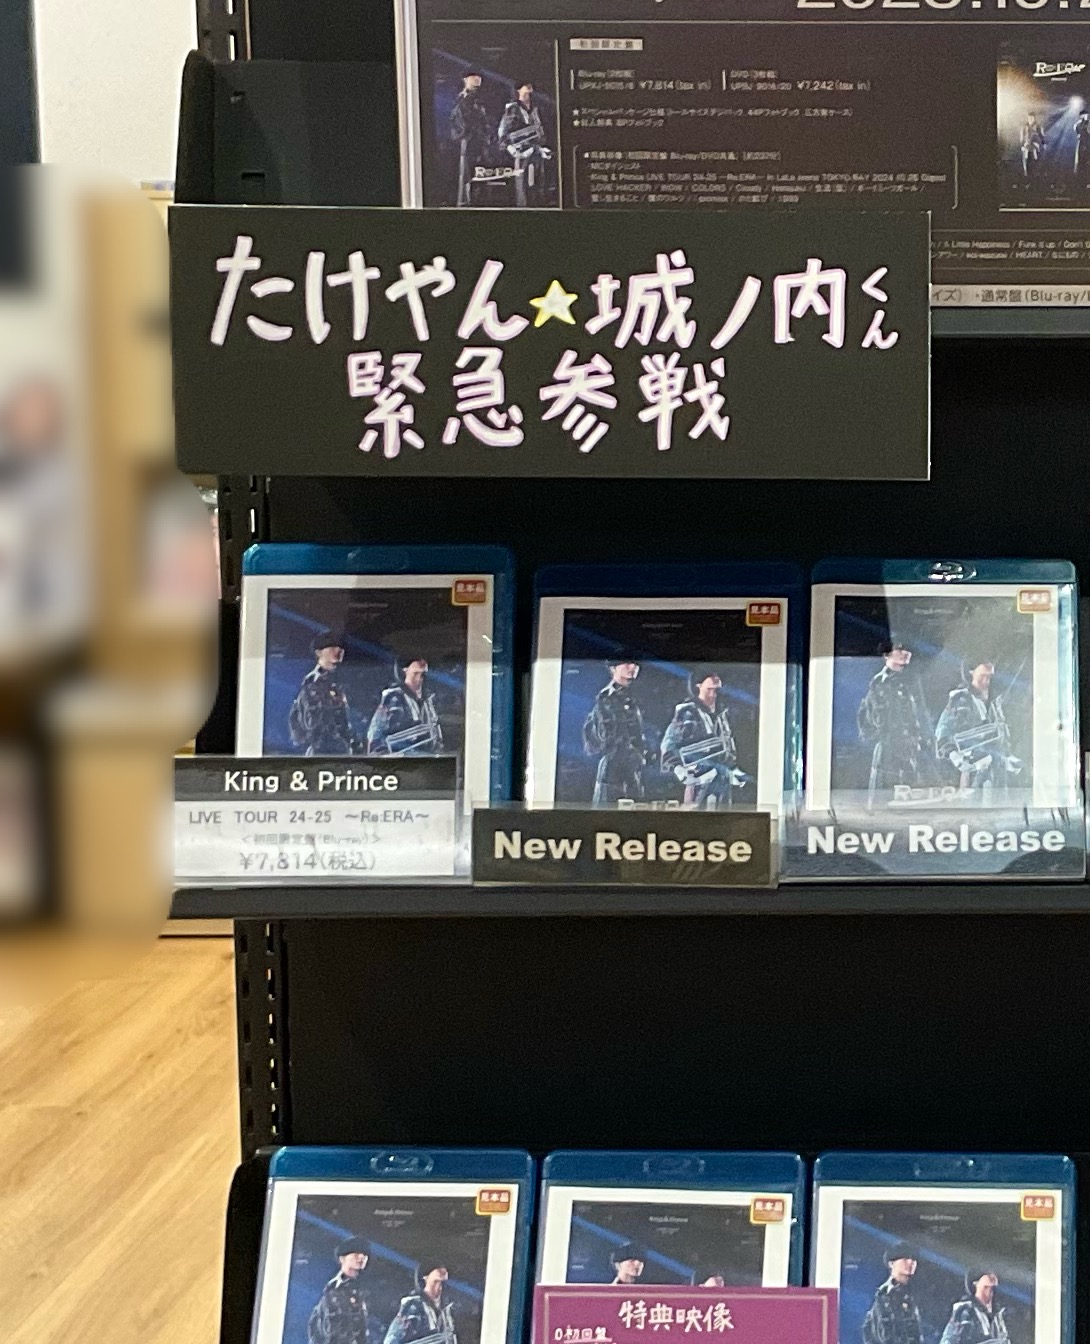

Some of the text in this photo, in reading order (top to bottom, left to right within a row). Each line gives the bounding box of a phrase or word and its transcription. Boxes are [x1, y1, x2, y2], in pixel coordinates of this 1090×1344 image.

[347, 347, 731, 458] 緊急参戦
[224, 771, 399, 794] King & Prince
[189, 811, 222, 824] LIVE
[234, 810, 278, 824] TOUR
[289, 810, 332, 823] 24-25
[494, 831, 753, 863] New Release
[807, 824, 1066, 854] New Release
[618, 1299, 735, 1333] 特典映像
